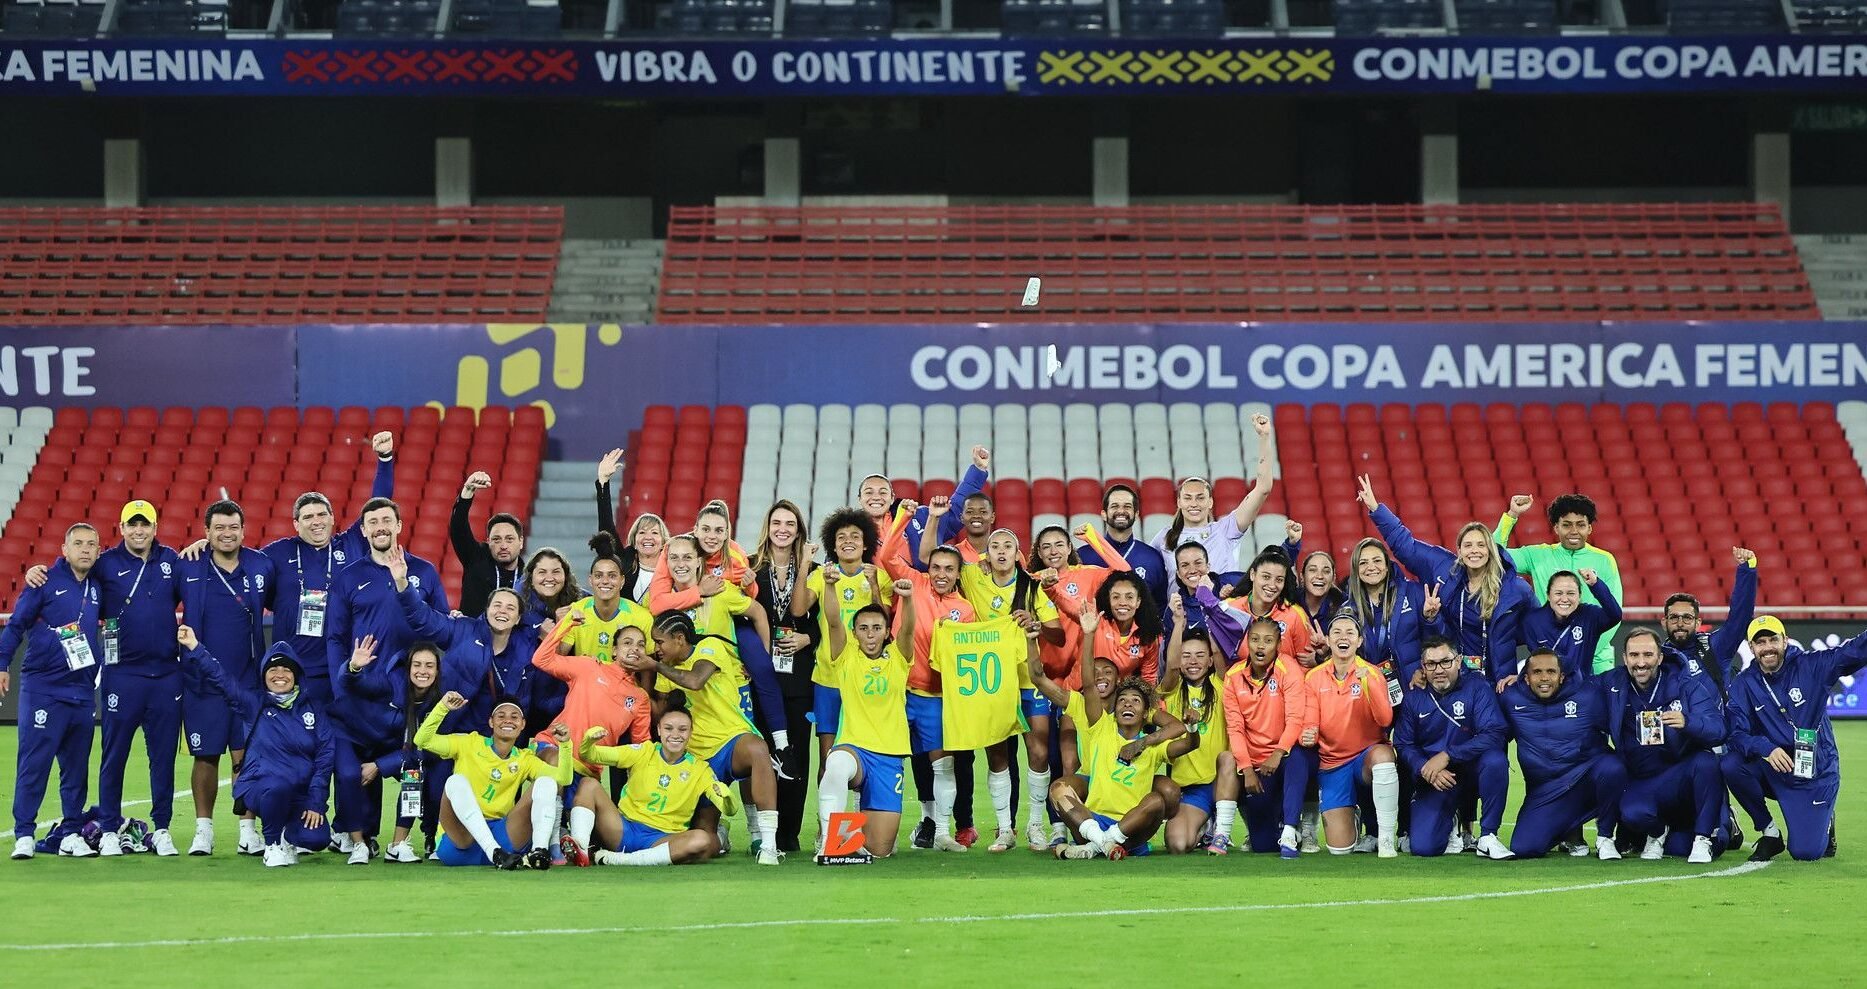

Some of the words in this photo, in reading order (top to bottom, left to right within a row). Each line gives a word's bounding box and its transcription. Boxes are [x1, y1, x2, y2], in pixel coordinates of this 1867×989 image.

[0, 50, 36, 81] A
[42, 49, 264, 81] FEMENINA
[595, 50, 717, 83] VIBRA
[733, 50, 757, 82] O
[772, 50, 1027, 82] CONTINENTE
[1353, 47, 1607, 80] CONMEBOL
[1615, 45, 1737, 78] COPA
[1744, 45, 1867, 77] AMER
[910, 344, 1238, 390] CONMEBOL
[1247, 344, 1407, 390] COPA
[1420, 343, 1686, 388] AMERICA
[1695, 343, 1867, 387] FEMEN
[953, 631, 1000, 644] ANTONIA
[863, 674, 888, 695] 20
[956, 651, 1002, 696] 50
[1110, 766, 1136, 787] 22
[481, 784, 495, 803] 4
[646, 792, 667, 812] 21
